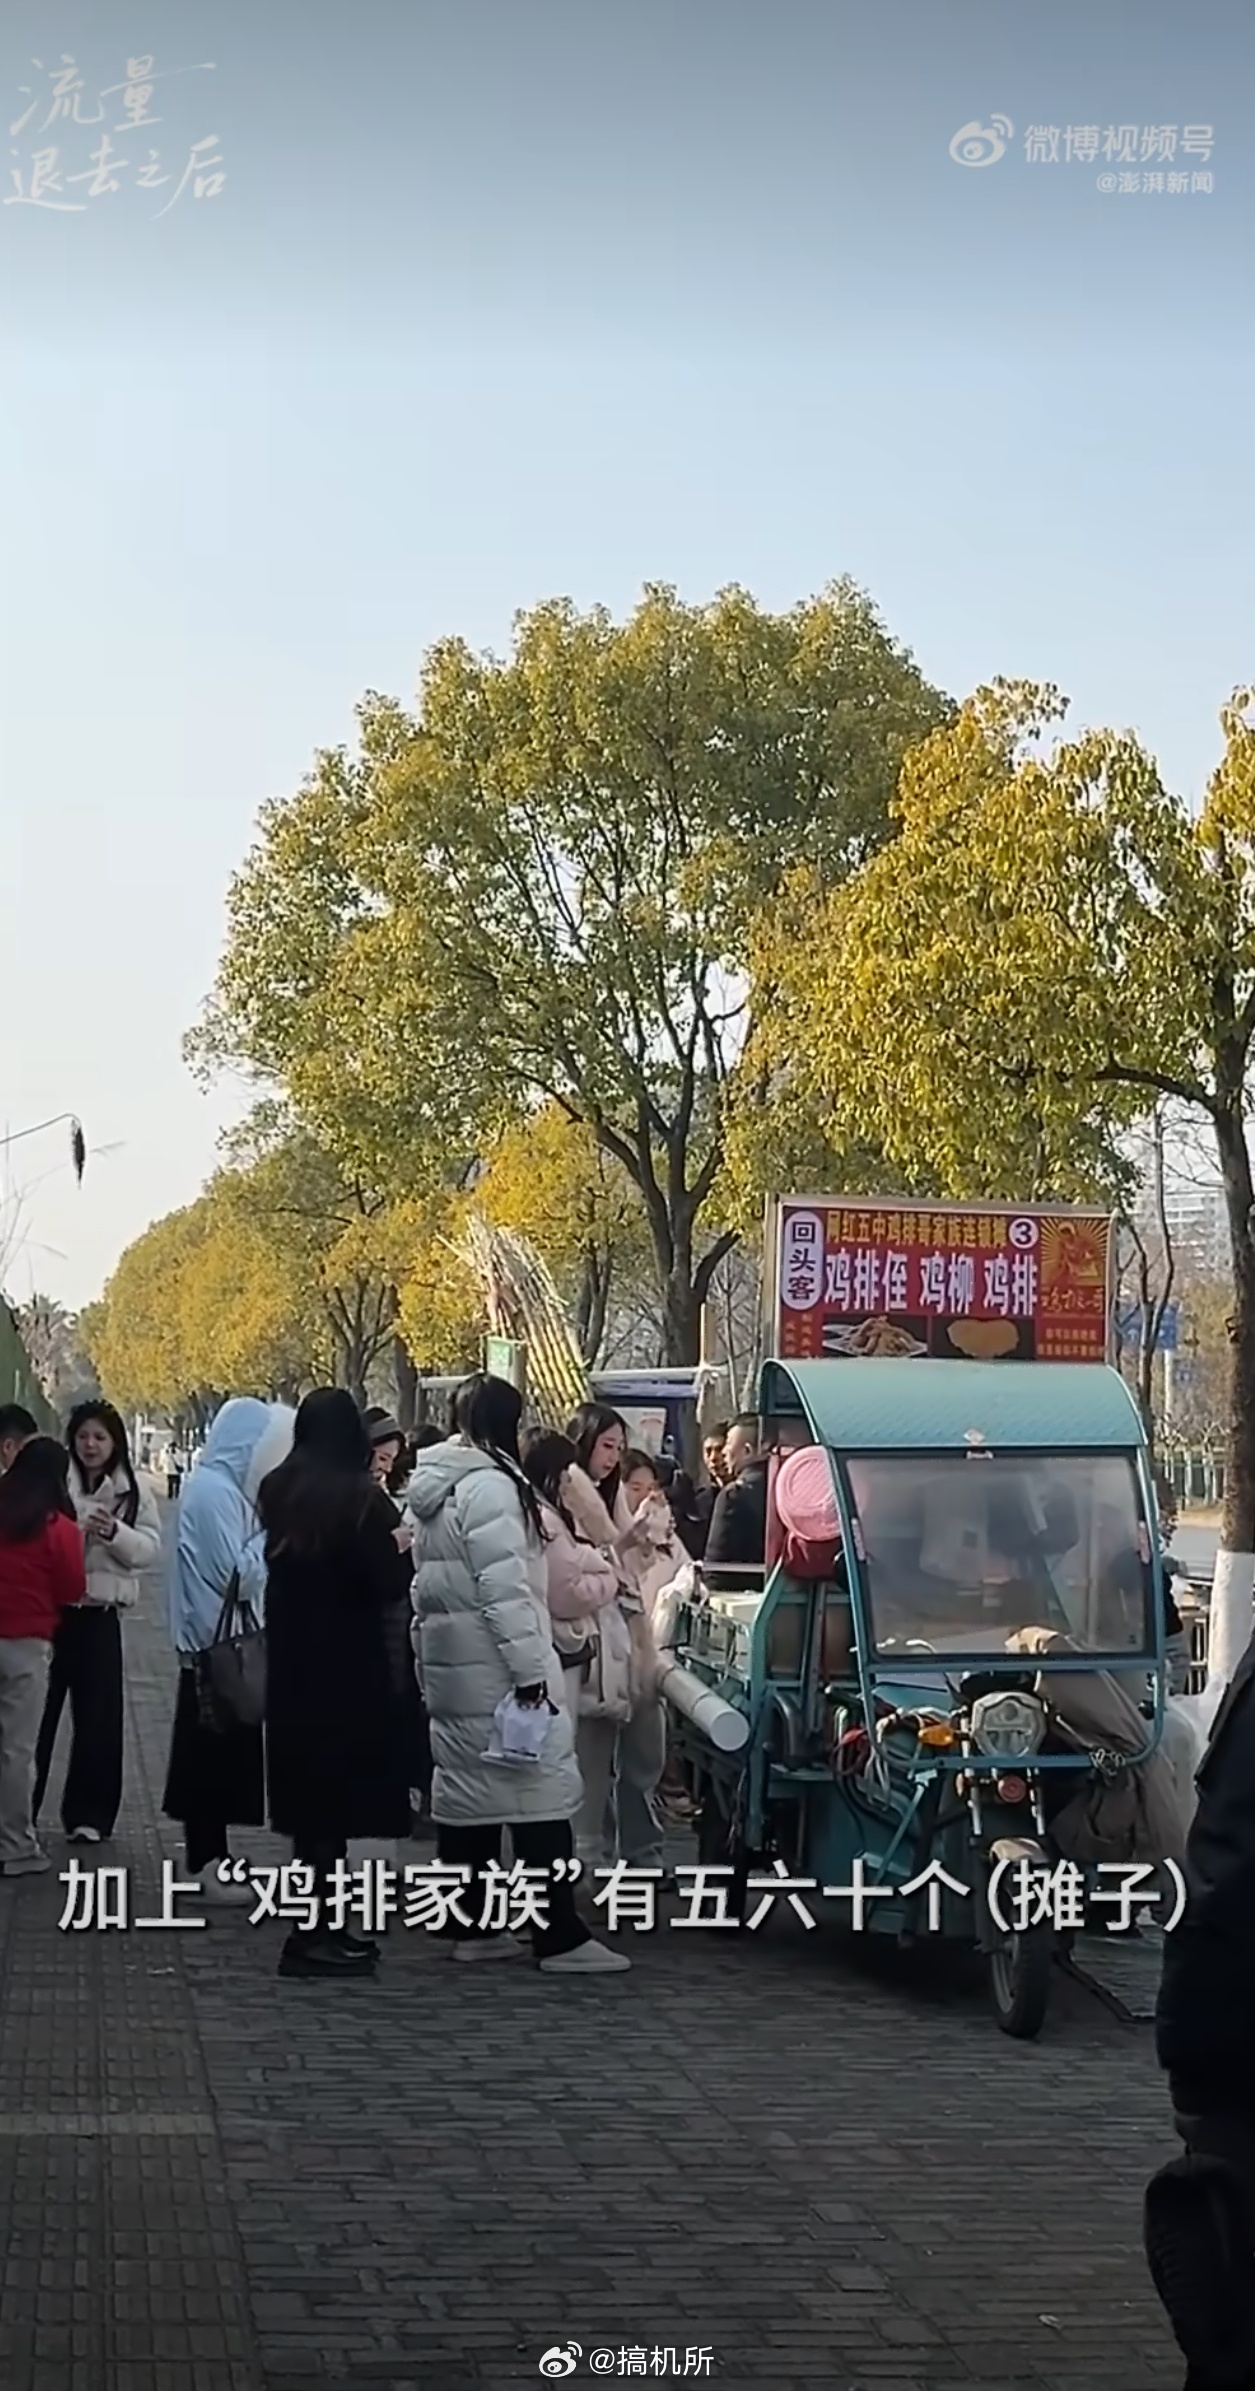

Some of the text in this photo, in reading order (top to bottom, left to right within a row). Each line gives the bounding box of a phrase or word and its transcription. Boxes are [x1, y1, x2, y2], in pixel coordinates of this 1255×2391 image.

[787, 1220, 816, 1301] 回头客
[824, 1247, 1038, 1316] 鸡排侄 鸡柳 鸡排
